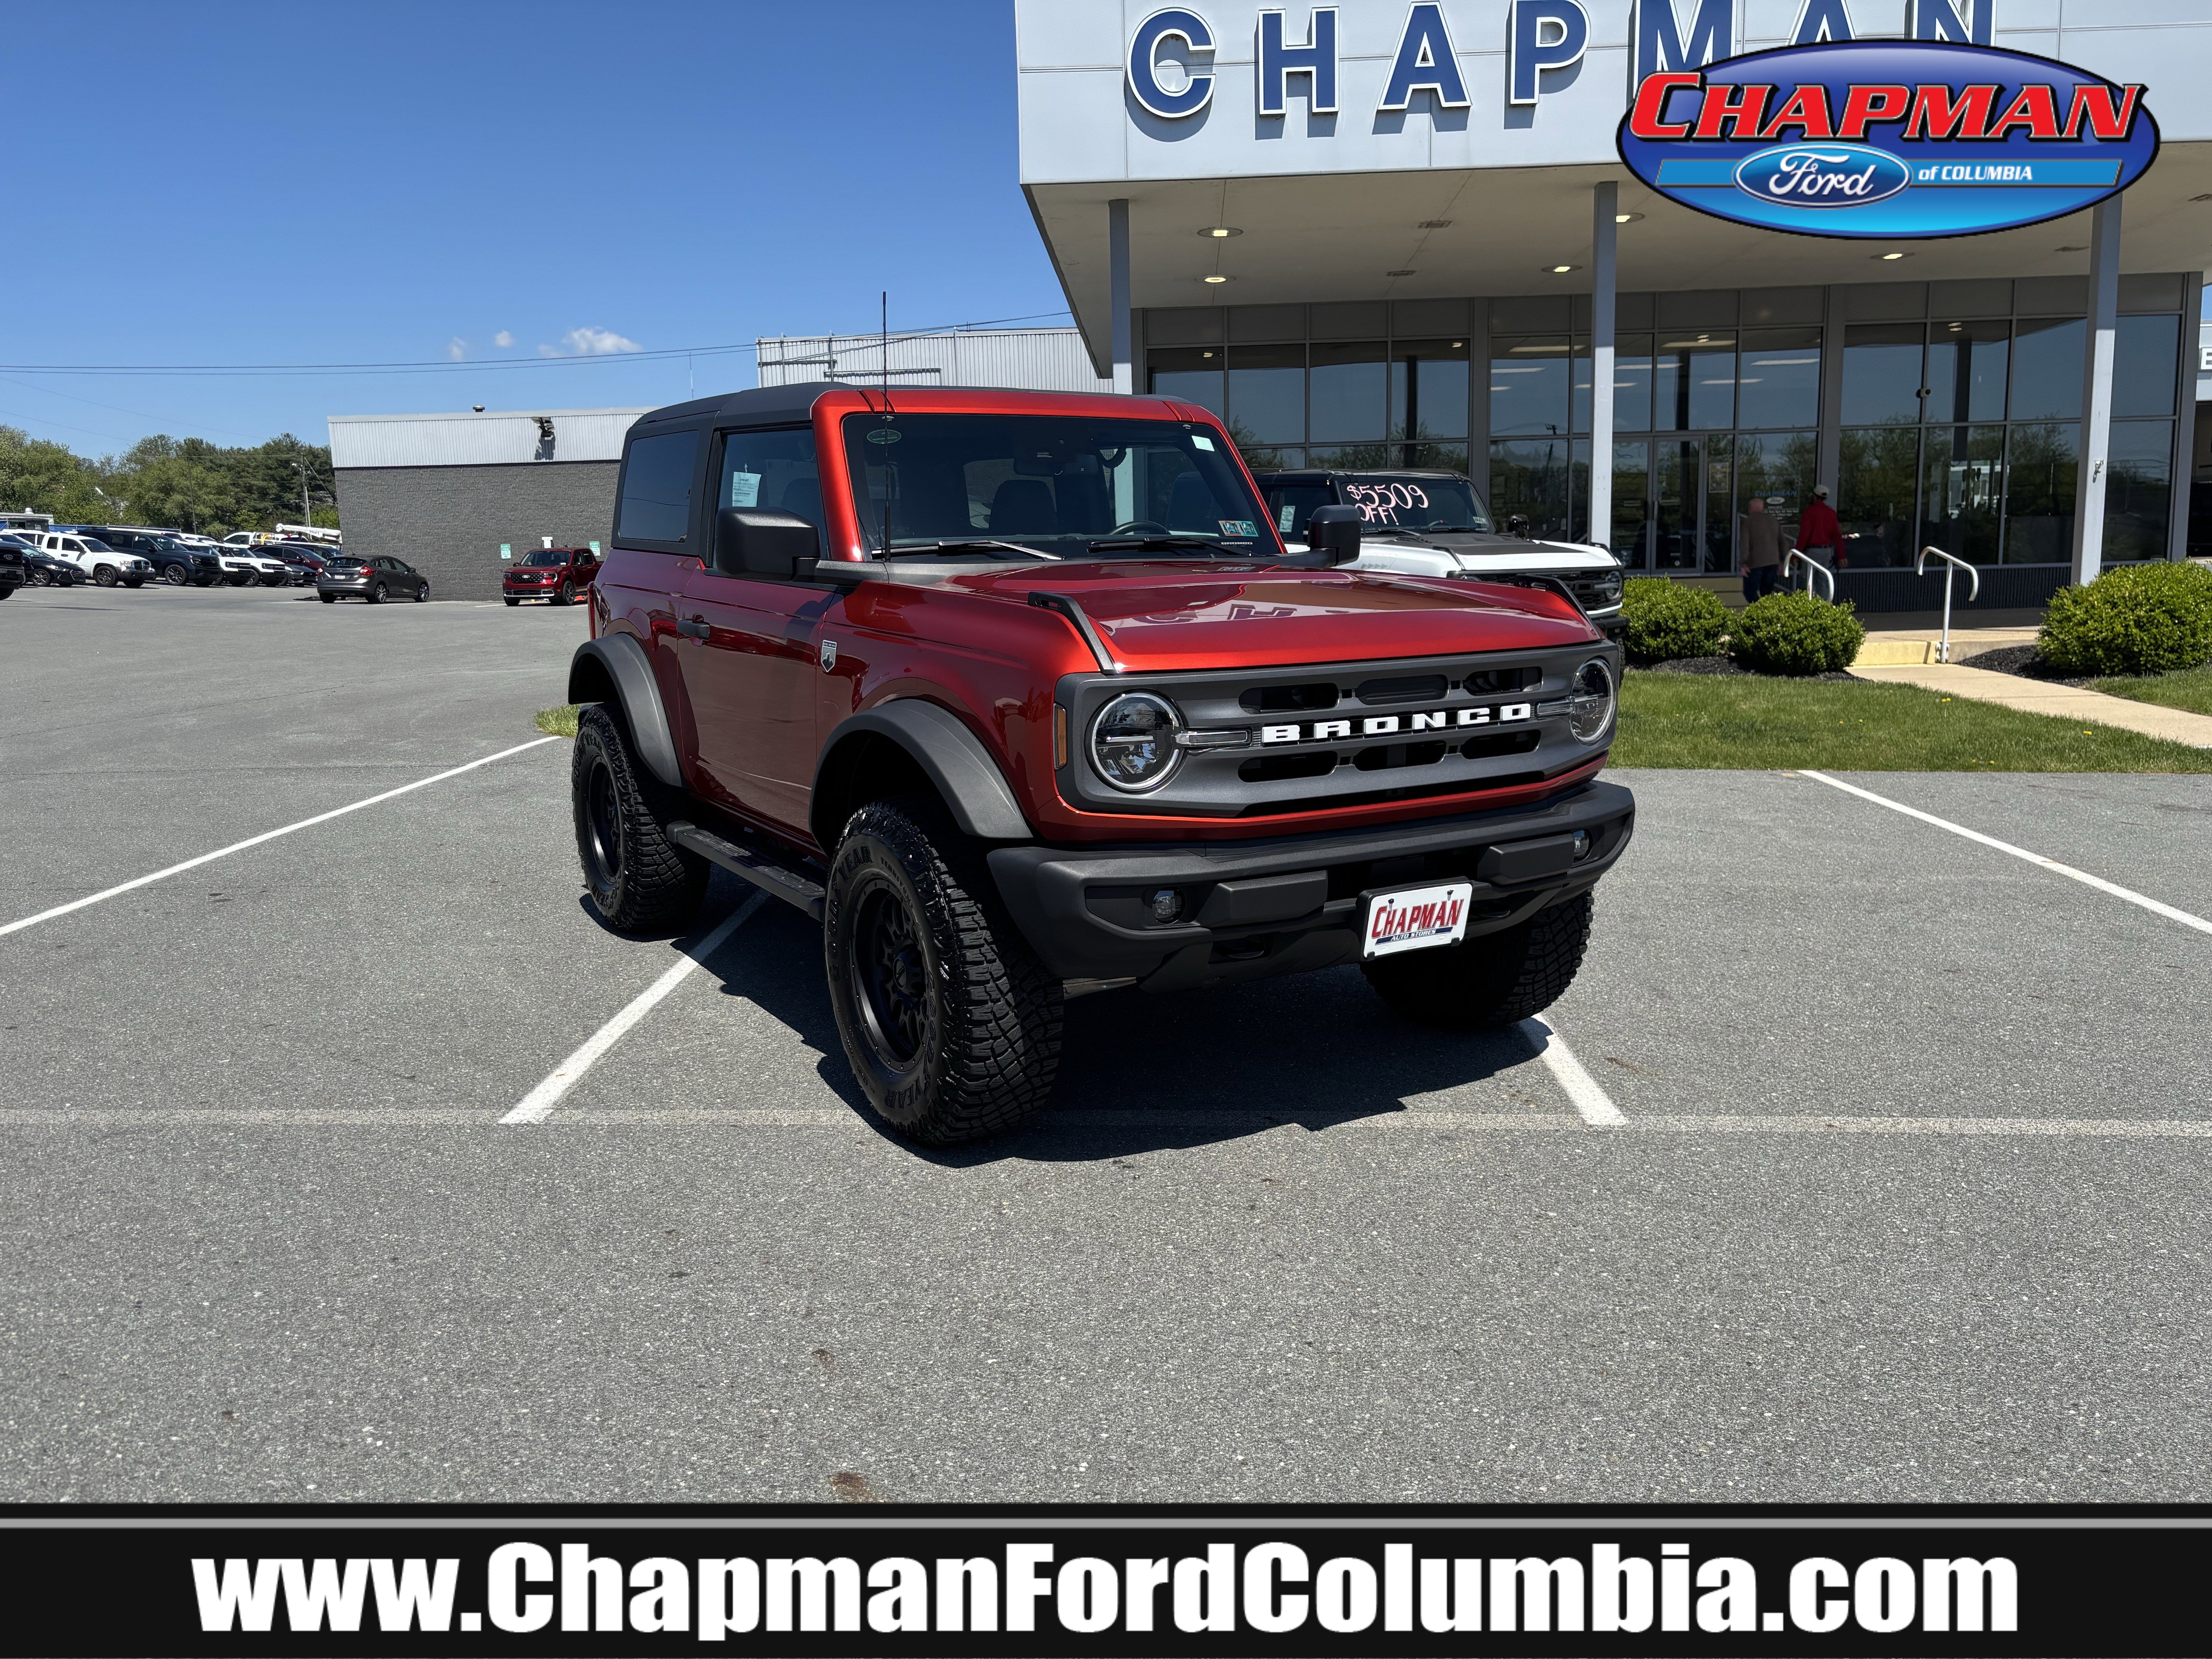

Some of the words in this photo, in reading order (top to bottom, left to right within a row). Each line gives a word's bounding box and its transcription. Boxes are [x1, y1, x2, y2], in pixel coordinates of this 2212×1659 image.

[1346, 483, 1429, 509] $5509
[1355, 503, 1400, 526] OFF!
[1261, 702, 1532, 744] BRONCO
[1371, 898, 1465, 939] CHAPMAN
[1390, 933, 1410, 942] AUTO
[1410, 929, 1437, 938] STORES
